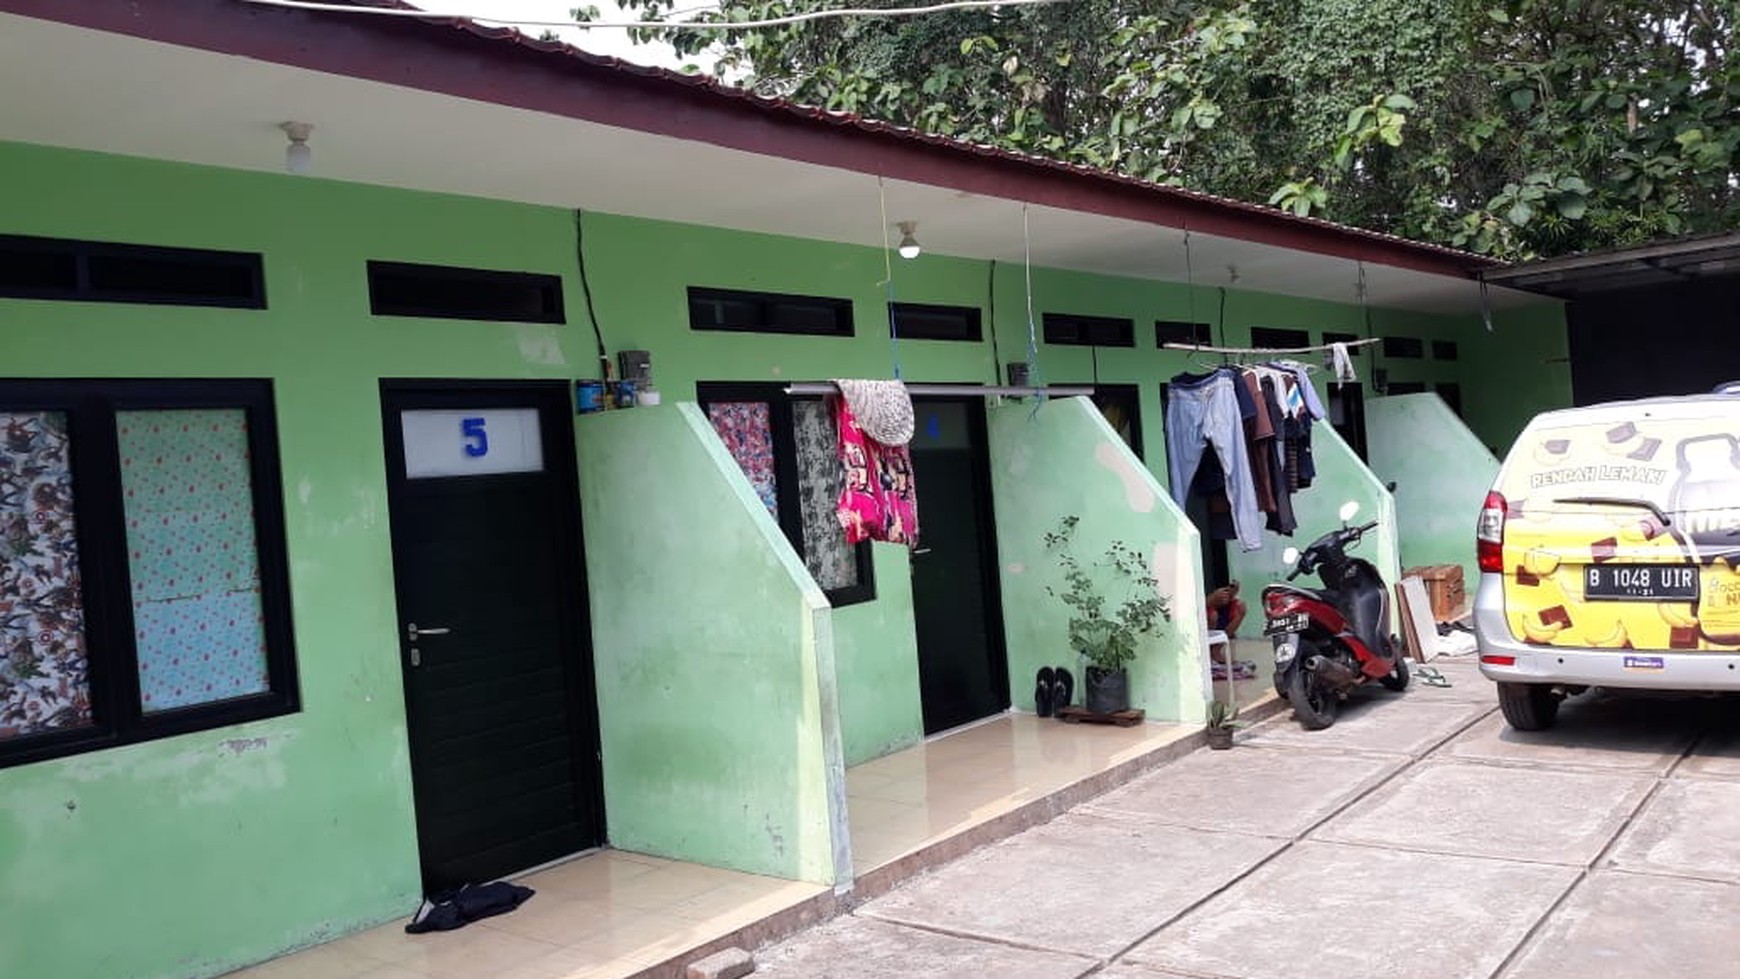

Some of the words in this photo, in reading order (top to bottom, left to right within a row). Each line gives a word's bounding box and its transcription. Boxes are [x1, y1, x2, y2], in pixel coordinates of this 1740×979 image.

[461, 417, 488, 457] 5
[1590, 569, 1600, 587] B
[1613, 568, 1651, 588] 1048
[1661, 568, 1693, 588] UIR
